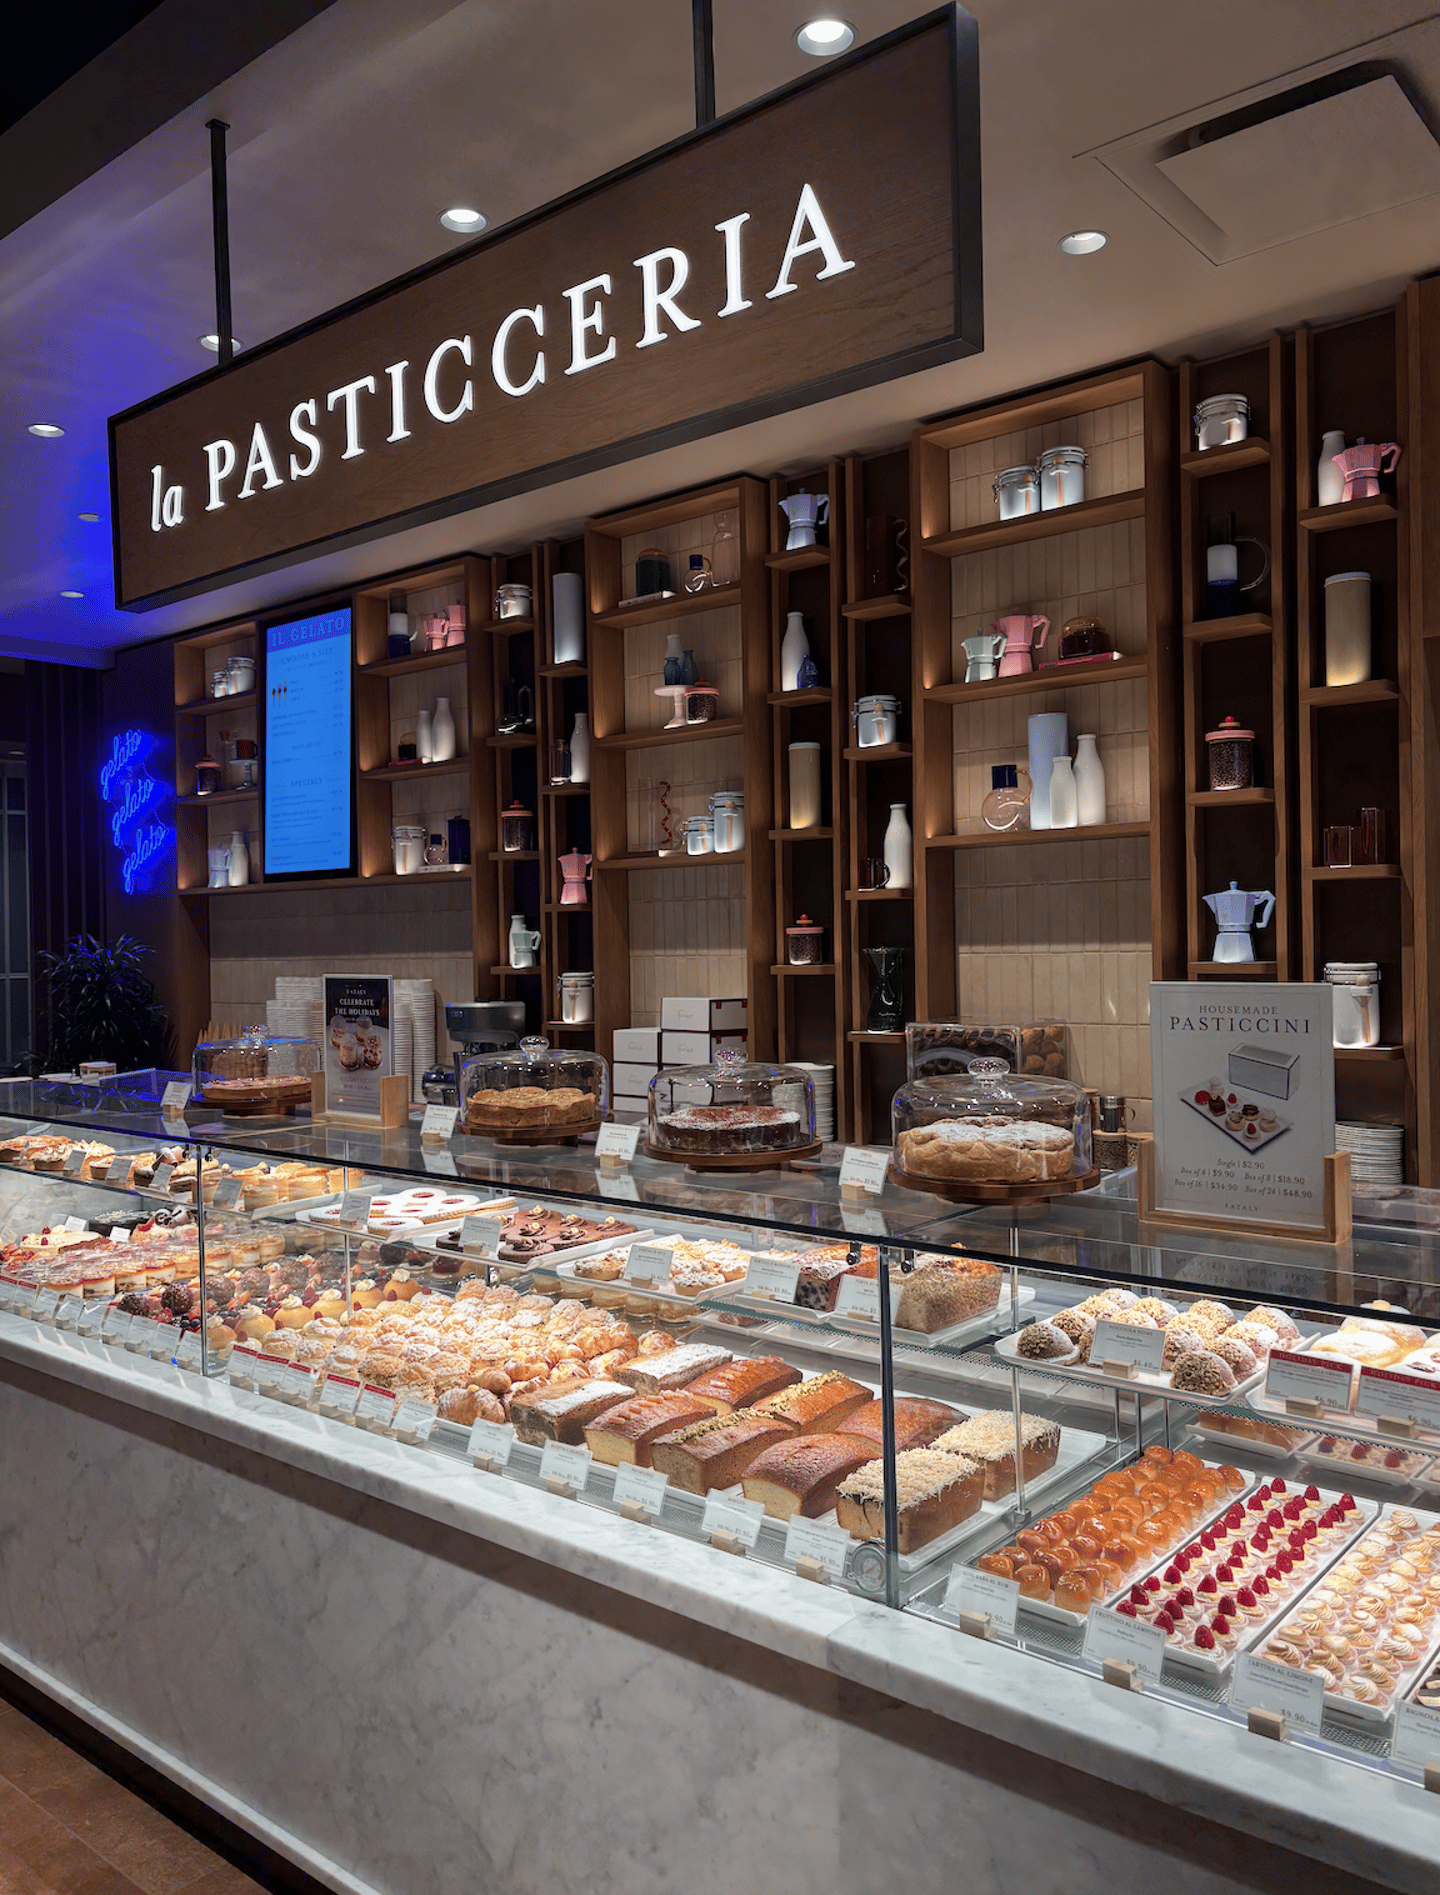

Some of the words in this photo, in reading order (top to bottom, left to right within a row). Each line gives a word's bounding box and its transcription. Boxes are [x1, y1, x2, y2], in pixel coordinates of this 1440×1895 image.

[148, 463, 183, 533] la
[203, 182, 857, 514] PASTICCERIA
[271, 630, 286, 647] IL
[290, 616, 345, 643] GELATO
[100, 729, 142, 801] gelato
[112, 779, 155, 847] gelato
[123, 825, 168, 894] gelato
[339, 998, 375, 1006] CELEBRATE
[334, 1007, 347, 1015] THE
[348, 1008, 380, 1017] HOLIDAYS
[1199, 1005, 1279, 1015] HOUSEMADE
[1169, 1016, 1310, 1034] PASTICCINI
[1216, 1158, 1236, 1170] Single
[1242, 1161, 1265, 1170] $2.90
[1180, 1166, 1192, 1174] Box
[1213, 1169, 1235, 1178] $9.90
[1244, 1172, 1256, 1180] Box
[1257, 1174, 1265, 1184] of
[1278, 1175, 1306, 1185] $18.90
[1174, 1178, 1186, 1186] Box
[1245, 1185, 1257, 1193] Box
[1282, 1189, 1313, 1198] $48.90
[1224, 1203, 1258, 1212] EATALY
[1279, 1352, 1317, 1365] HOLIDAY
[1321, 1360, 1343, 1370] PICK
[1370, 1369, 1411, 1382] HOLIDAY
[1414, 1378, 1436, 1389] PICK
[1286, 1670, 1314, 1684] LIMONE
